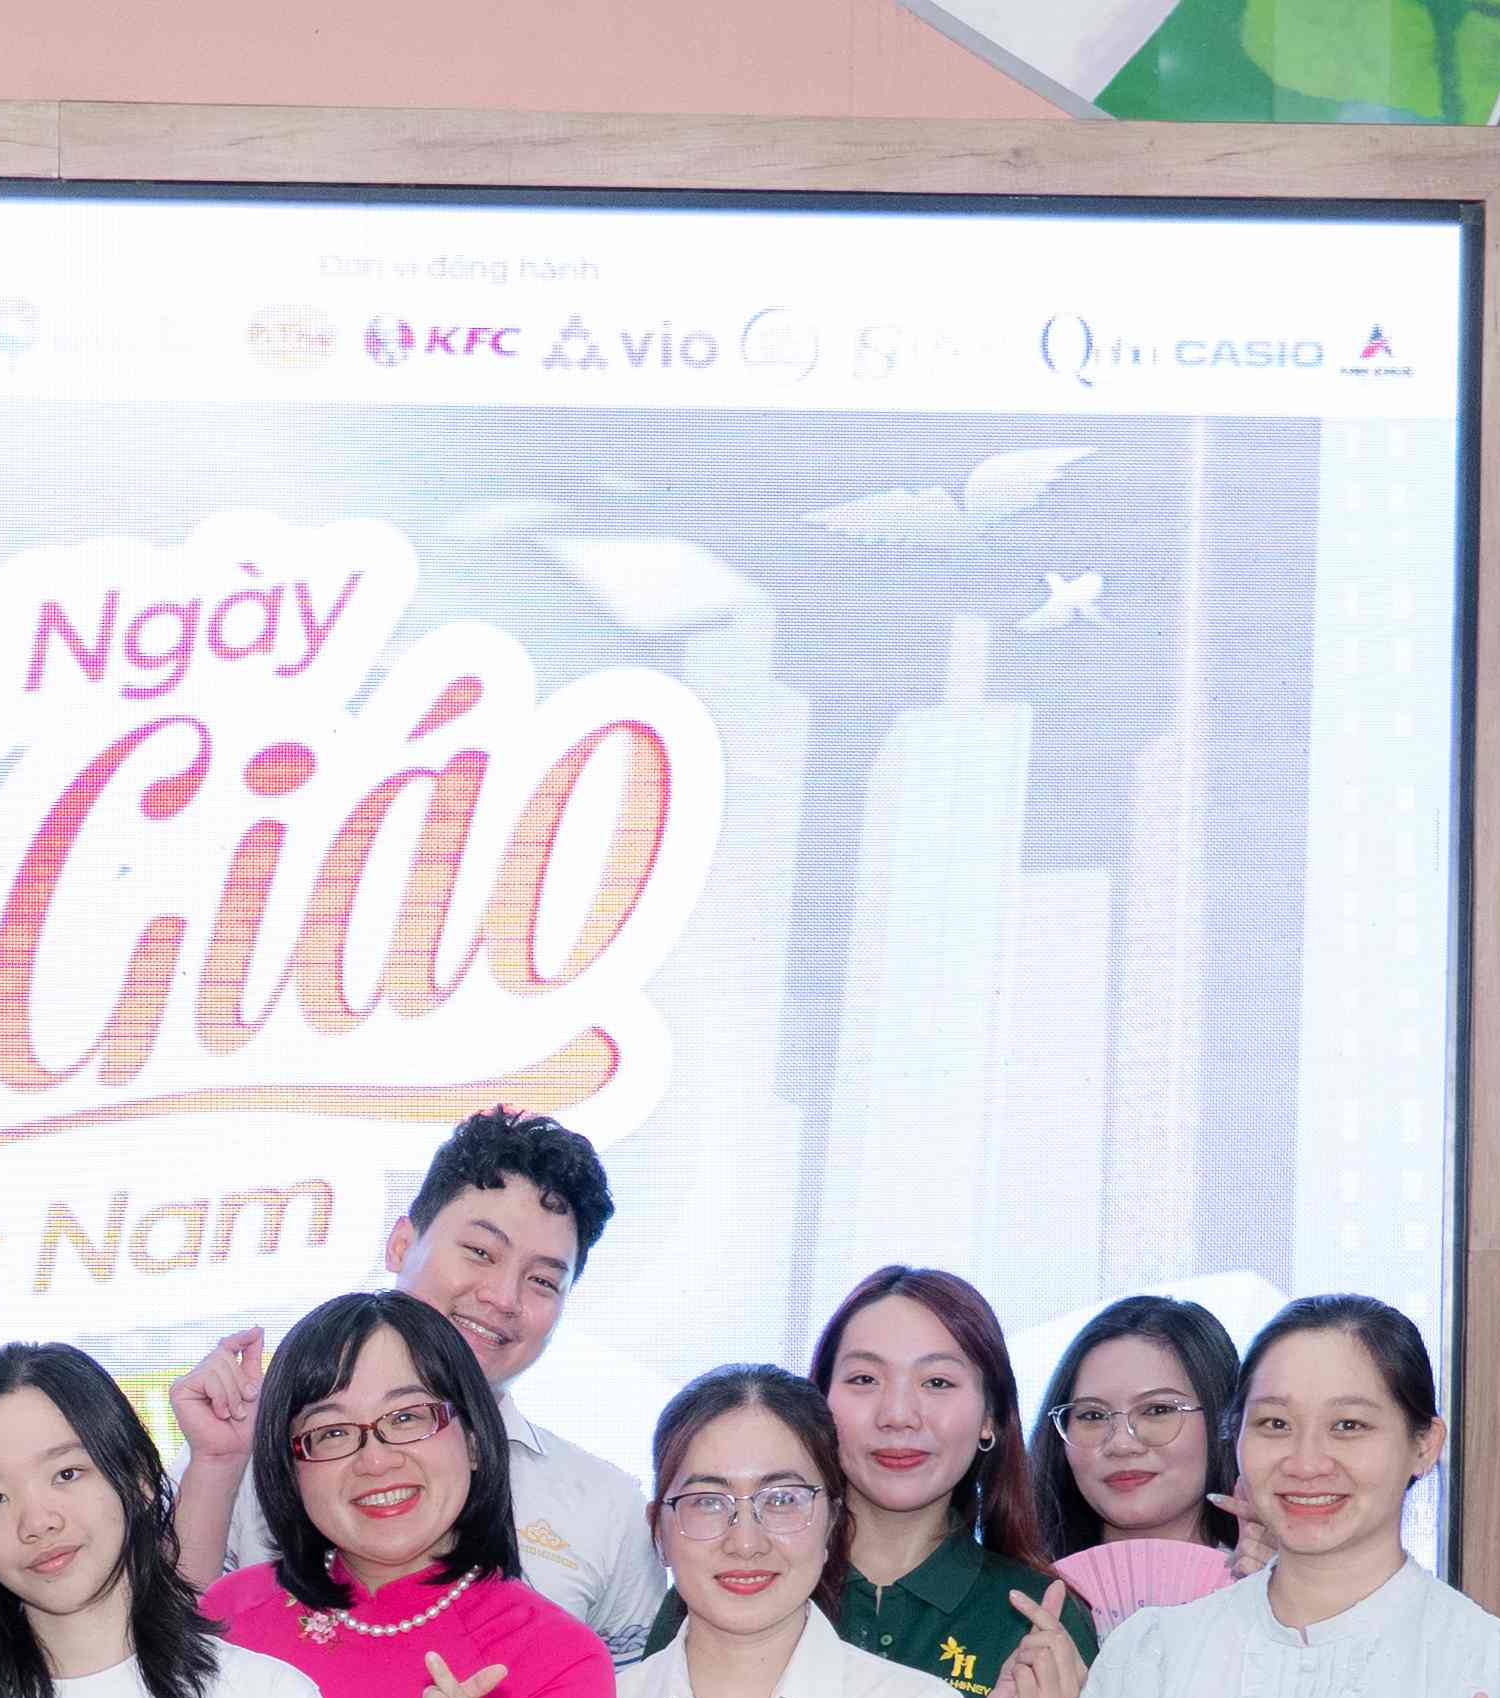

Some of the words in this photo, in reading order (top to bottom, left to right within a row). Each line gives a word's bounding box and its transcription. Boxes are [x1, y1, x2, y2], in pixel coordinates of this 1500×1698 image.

[423, 326, 522, 358] KFC
[619, 320, 720, 370] vio
[1173, 337, 1326, 369] CASIO
[24, 562, 366, 699] Ngày
[31, 1177, 336, 1296] Nam
[951, 1679, 992, 1697] HONEY
